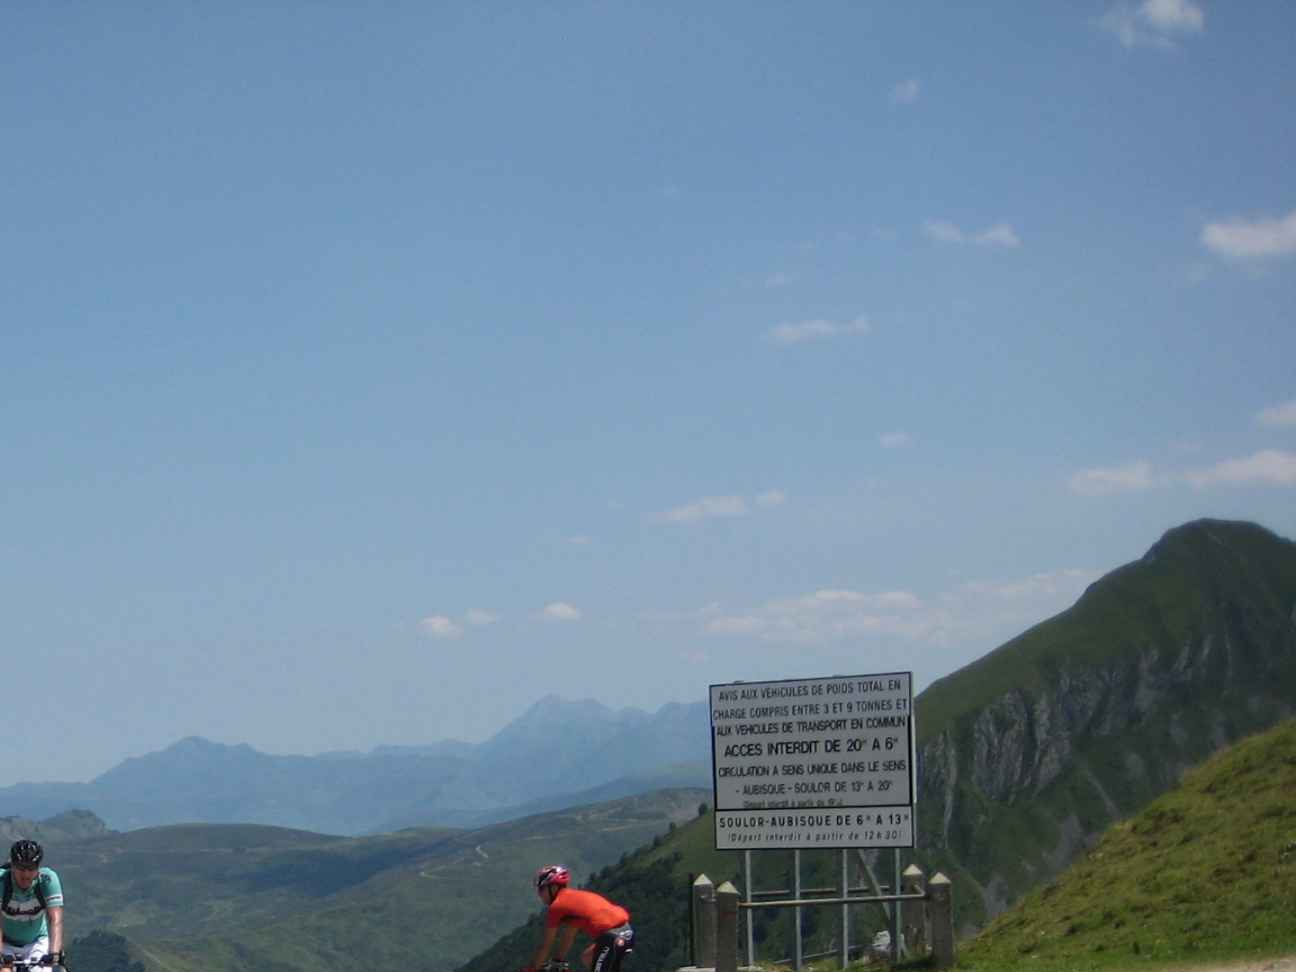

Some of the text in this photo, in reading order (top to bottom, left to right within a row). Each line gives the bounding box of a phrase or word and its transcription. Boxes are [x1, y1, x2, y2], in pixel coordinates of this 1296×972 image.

[719, 690, 737, 701] AVIS
[741, 688, 758, 698] AUX
[812, 685, 823, 696] DE
[827, 683, 853, 694] POIDS
[858, 680, 884, 692] TOTAL
[888, 679, 901, 690] EN
[713, 709, 746, 720] CHARGE
[750, 706, 789, 718] COMPRIS
[792, 703, 820, 716] ENTRE
[833, 703, 843, 713] ET
[847, 702, 853, 712] 9
[857, 699, 892, 712] TONNES
[896, 698, 906, 710] ET
[717, 725, 731, 736] AUX
[782, 722, 792, 733] DE
[796, 719, 846, 733] TRANSPORT
[851, 719, 863, 729] EN
[866, 716, 905, 728] COMMUN
[767, 740, 819, 755] INTERDIT
[825, 739, 840, 752] DE
[872, 738, 880, 750] A
[718, 760, 906, 777] CIRCULATION A SENS UNIQUE DANS LE SENS
[835, 782, 847, 792] DE
[867, 781, 874, 791] A
[837, 815, 851, 825] DE
[876, 814, 882, 825] A
